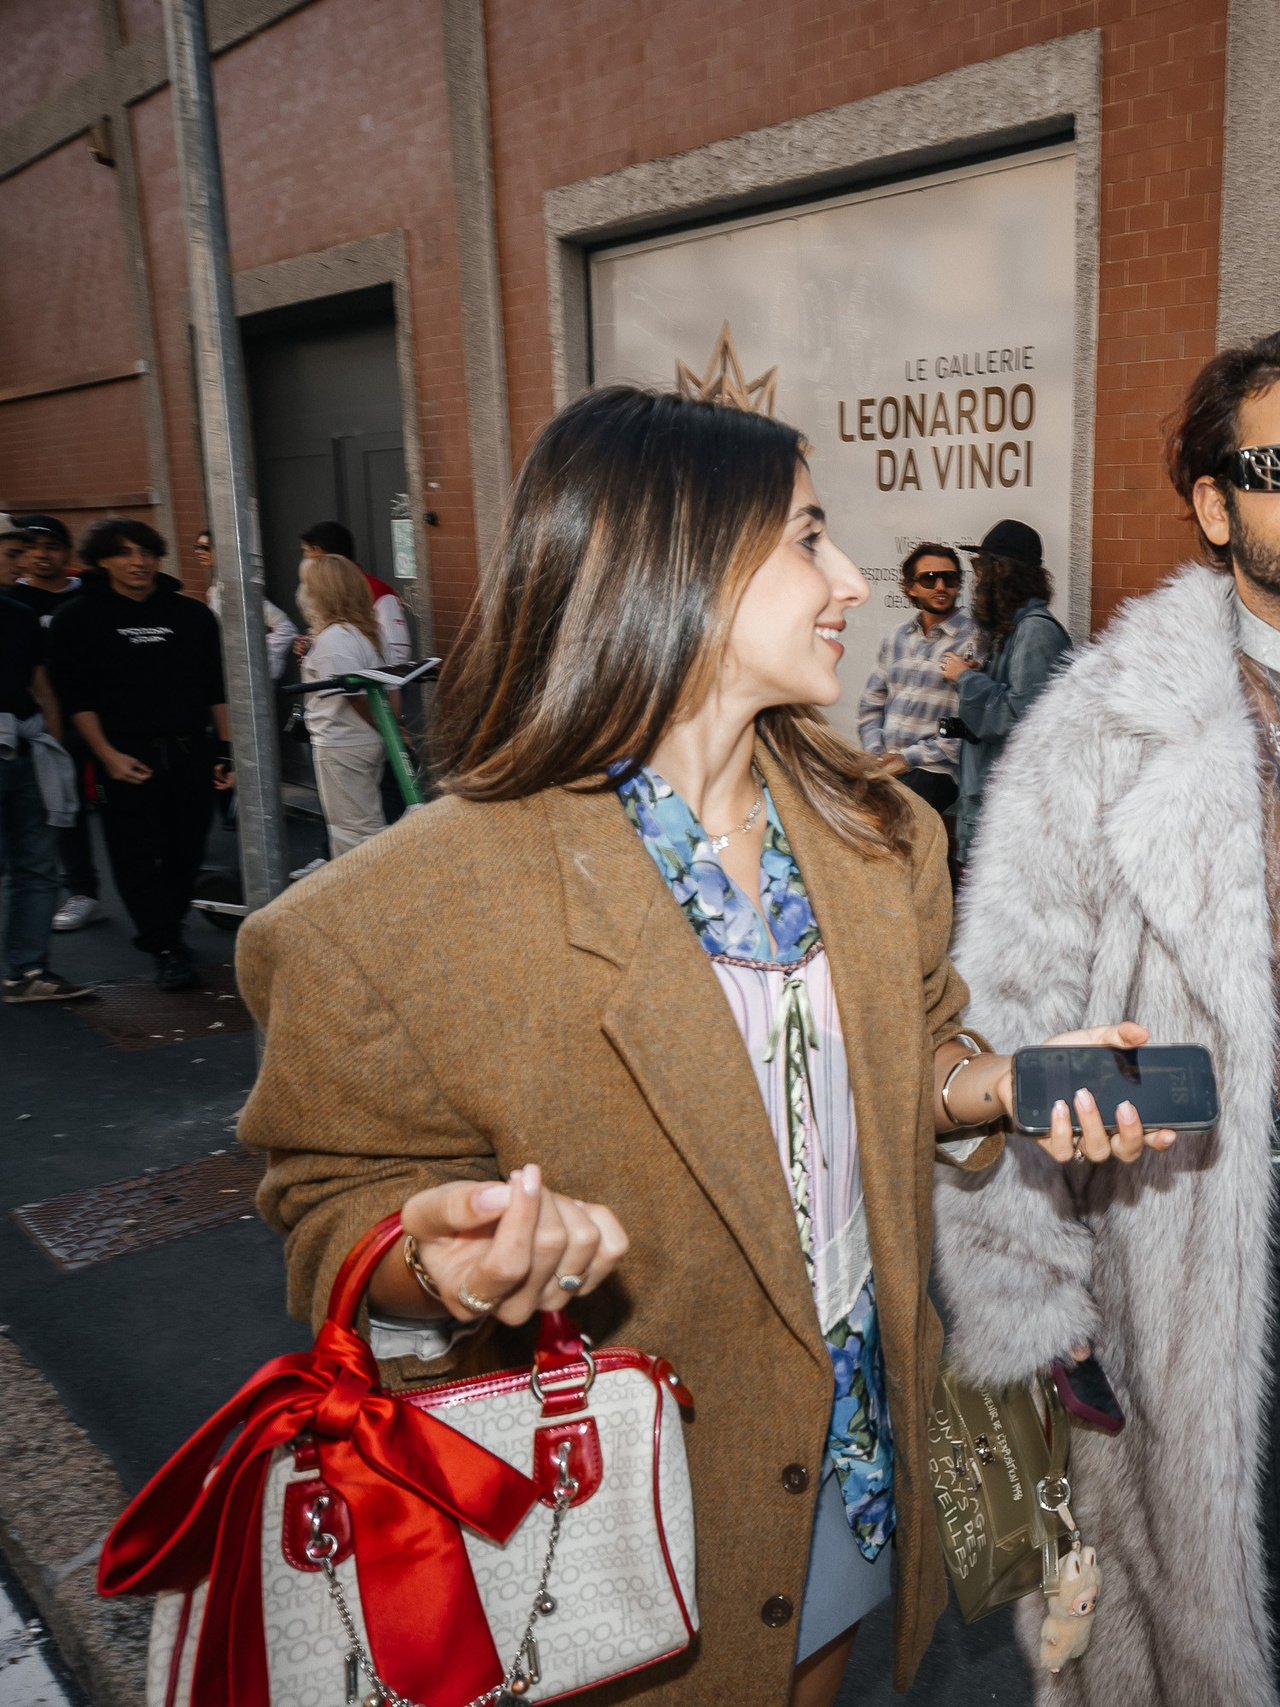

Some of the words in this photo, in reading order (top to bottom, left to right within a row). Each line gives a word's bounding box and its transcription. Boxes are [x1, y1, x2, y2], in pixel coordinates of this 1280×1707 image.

[905, 358, 928, 382] LE
[934, 345, 1035, 379] GALLERIE
[837, 382, 1036, 443] LEONARDO
[876, 449, 923, 492] DA
[930, 440, 1034, 490] VINCI
[929, 1457, 970, 1580] RVEILLES
[939, 1455, 970, 1512] PAYS
[963, 1519, 979, 1568] DES
